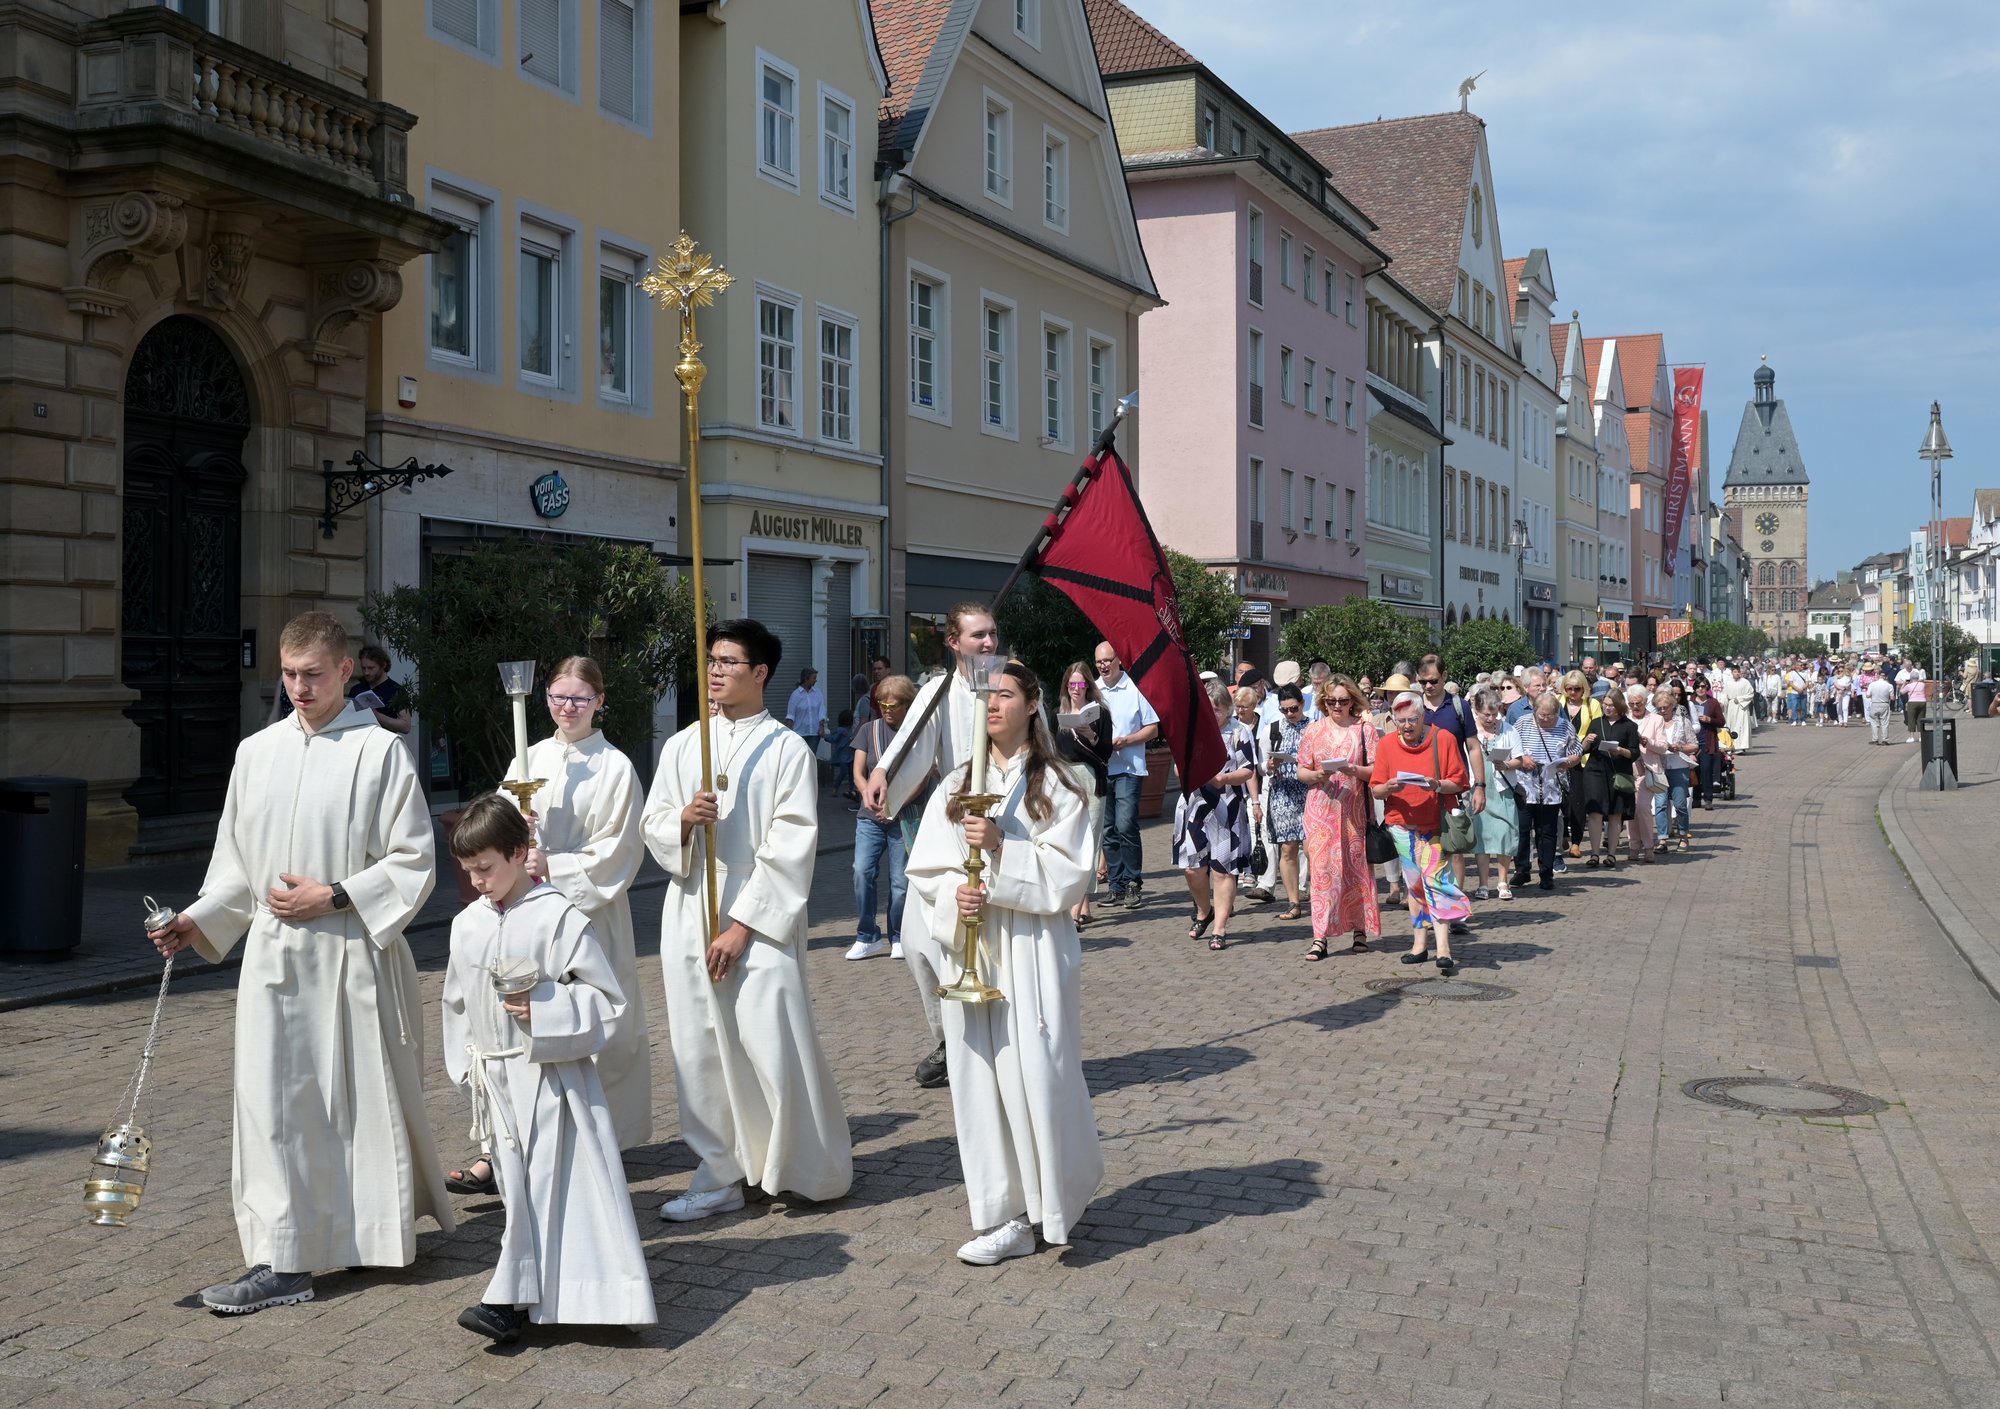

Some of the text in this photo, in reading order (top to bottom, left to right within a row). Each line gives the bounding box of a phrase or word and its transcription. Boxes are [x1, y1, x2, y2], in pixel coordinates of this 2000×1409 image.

[534, 479, 554, 497] vom
[1666, 418, 1694, 537] CHRISTMANN
[541, 487, 569, 514] FASS
[749, 509, 809, 540] AUGUST
